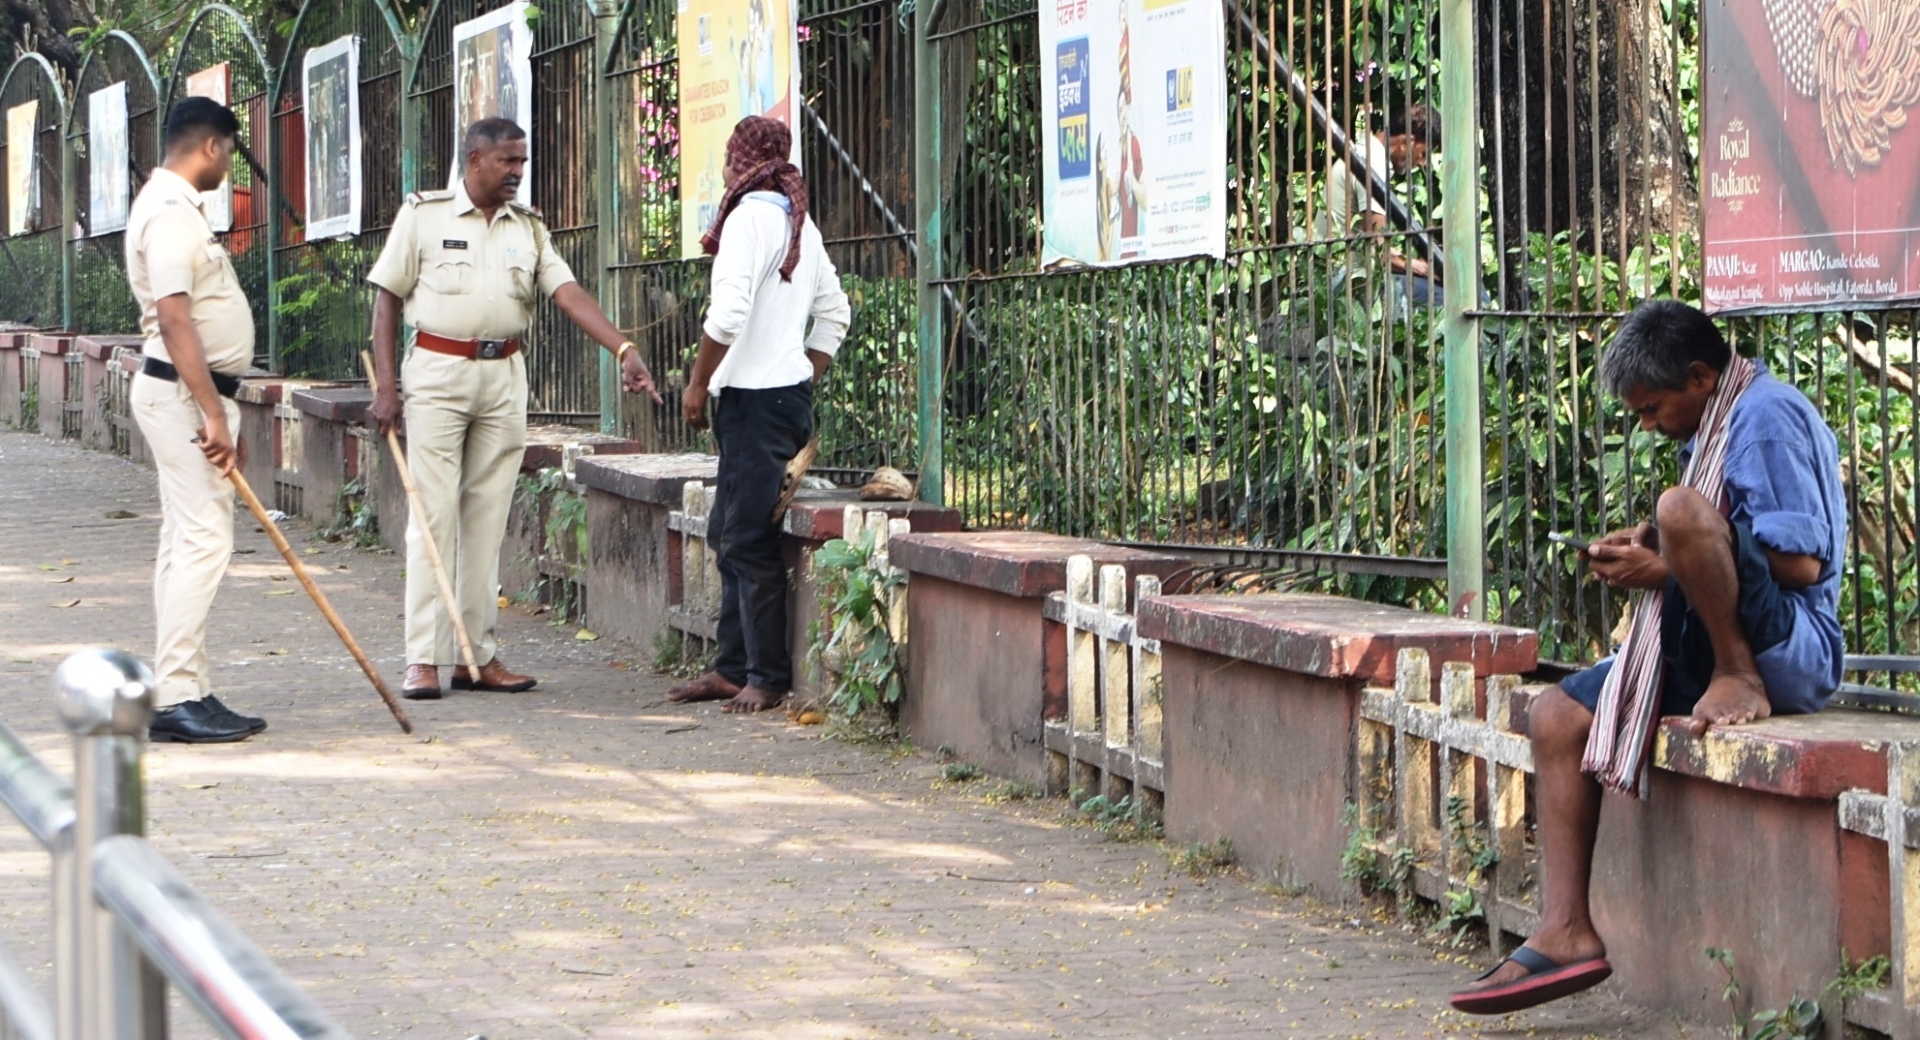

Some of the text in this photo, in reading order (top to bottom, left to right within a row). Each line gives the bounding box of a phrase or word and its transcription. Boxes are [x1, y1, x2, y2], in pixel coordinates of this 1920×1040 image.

[711, 78, 730, 97] REASON
[1178, 69, 1192, 106] LIC
[689, 109, 698, 125] FOR
[1059, 113, 1087, 164] प्लस
[1720, 128, 1750, 166] Royal
[1711, 167, 1761, 198] Radiance
[1707, 254, 1740, 278] PANAJI:
[1779, 248, 1826, 273] MARGAO:
